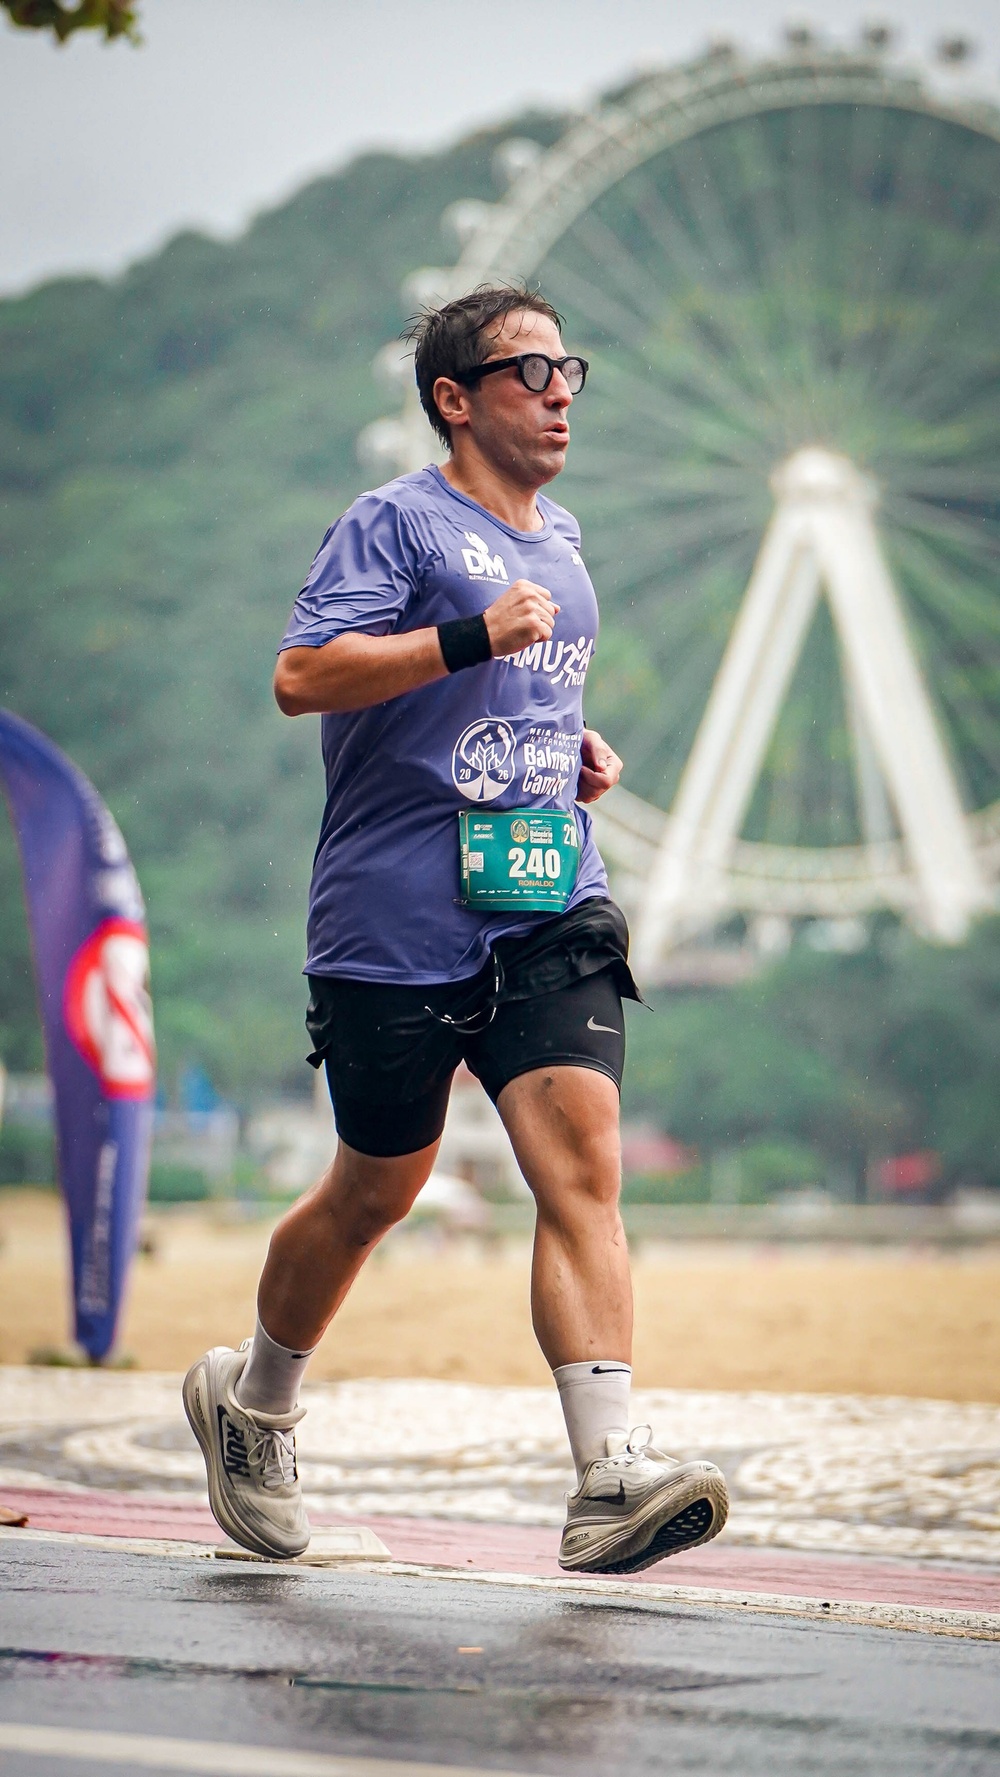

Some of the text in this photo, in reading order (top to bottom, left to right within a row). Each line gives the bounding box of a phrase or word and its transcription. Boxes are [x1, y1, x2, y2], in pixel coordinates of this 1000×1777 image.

[461, 548, 509, 580] DM
[529, 727, 551, 737] MEIA
[459, 768, 509, 780] 20 26
[508, 847, 561, 879] 240
[226, 1421, 250, 1477] RUN
